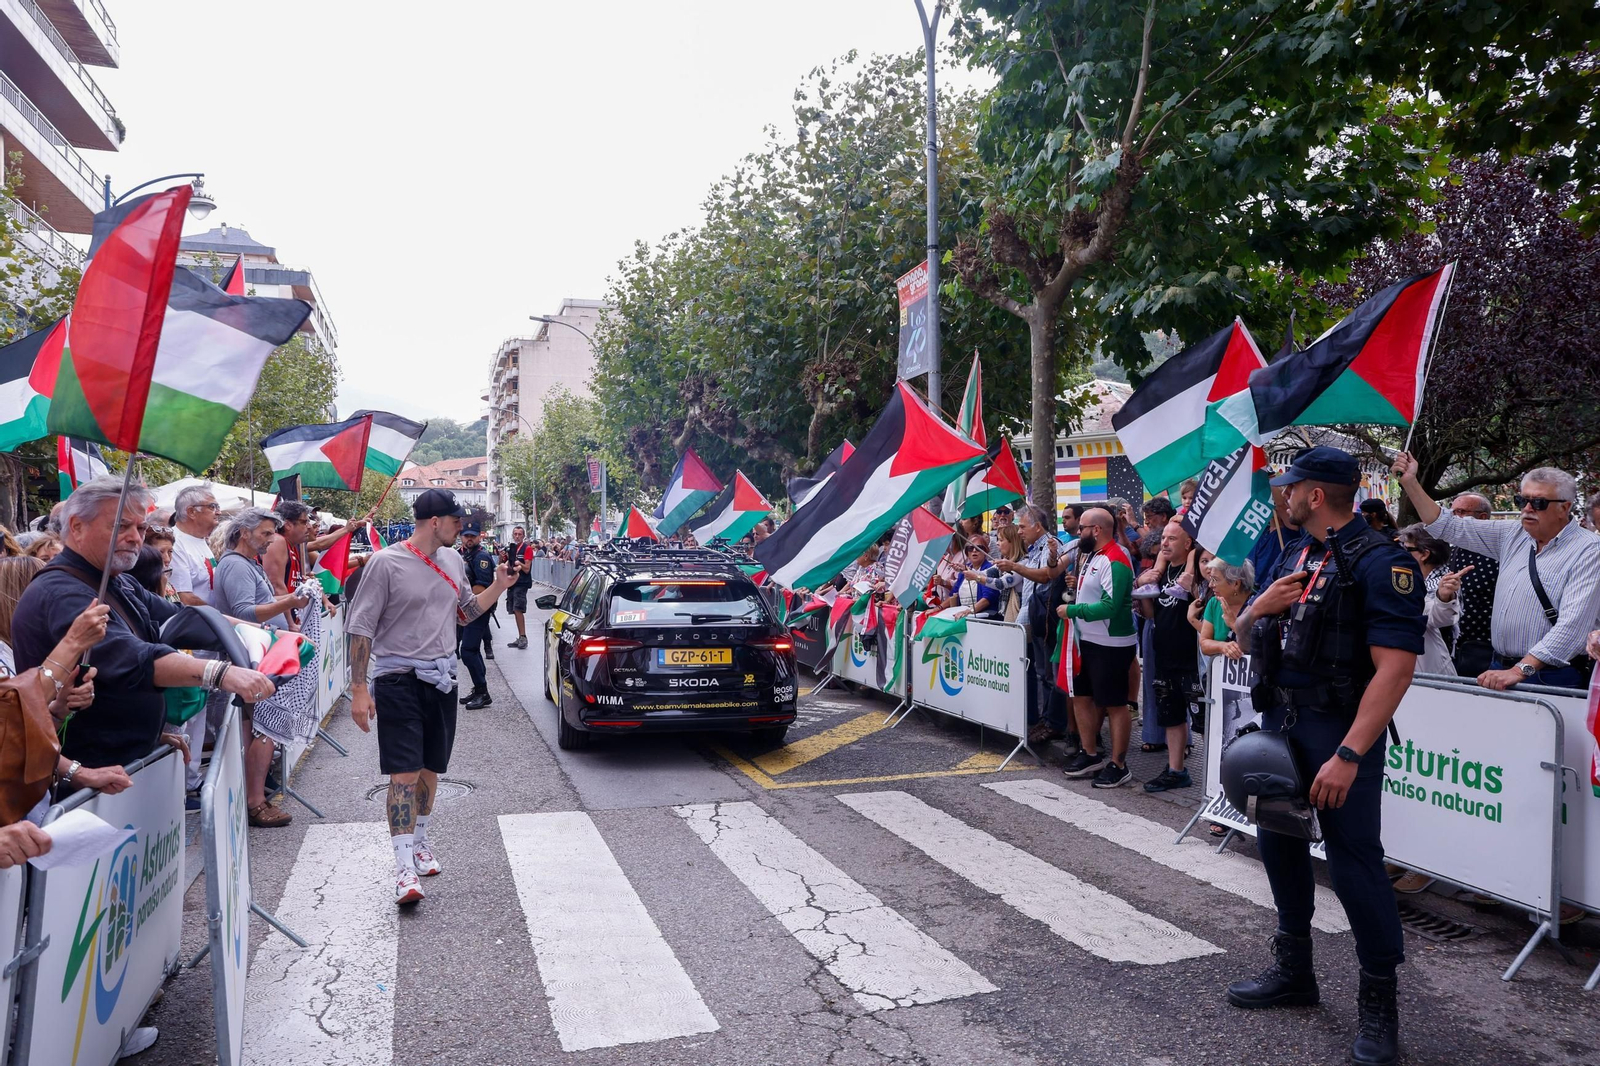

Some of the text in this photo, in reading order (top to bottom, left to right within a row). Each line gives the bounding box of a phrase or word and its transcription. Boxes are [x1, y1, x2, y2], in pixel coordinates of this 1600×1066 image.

[657, 633, 735, 641] SKODA
[671, 650, 725, 663] GZP-61-T
[967, 648, 1010, 678] Asturias
[1222, 655, 1251, 689] ISR
[668, 678, 720, 687] SKODA
[773, 685, 793, 695] lease
[966, 673, 1010, 694] paraíso natural
[597, 694, 624, 706] VISMA
[632, 701, 758, 710] www.teamvismaleaseabike.com
[774, 695, 780, 703] a
[1384, 738, 1503, 794] sturias
[1382, 775, 1502, 824] raíso natural
[139, 818, 181, 893] Asturias
[136, 860, 180, 938] paraíso natural
